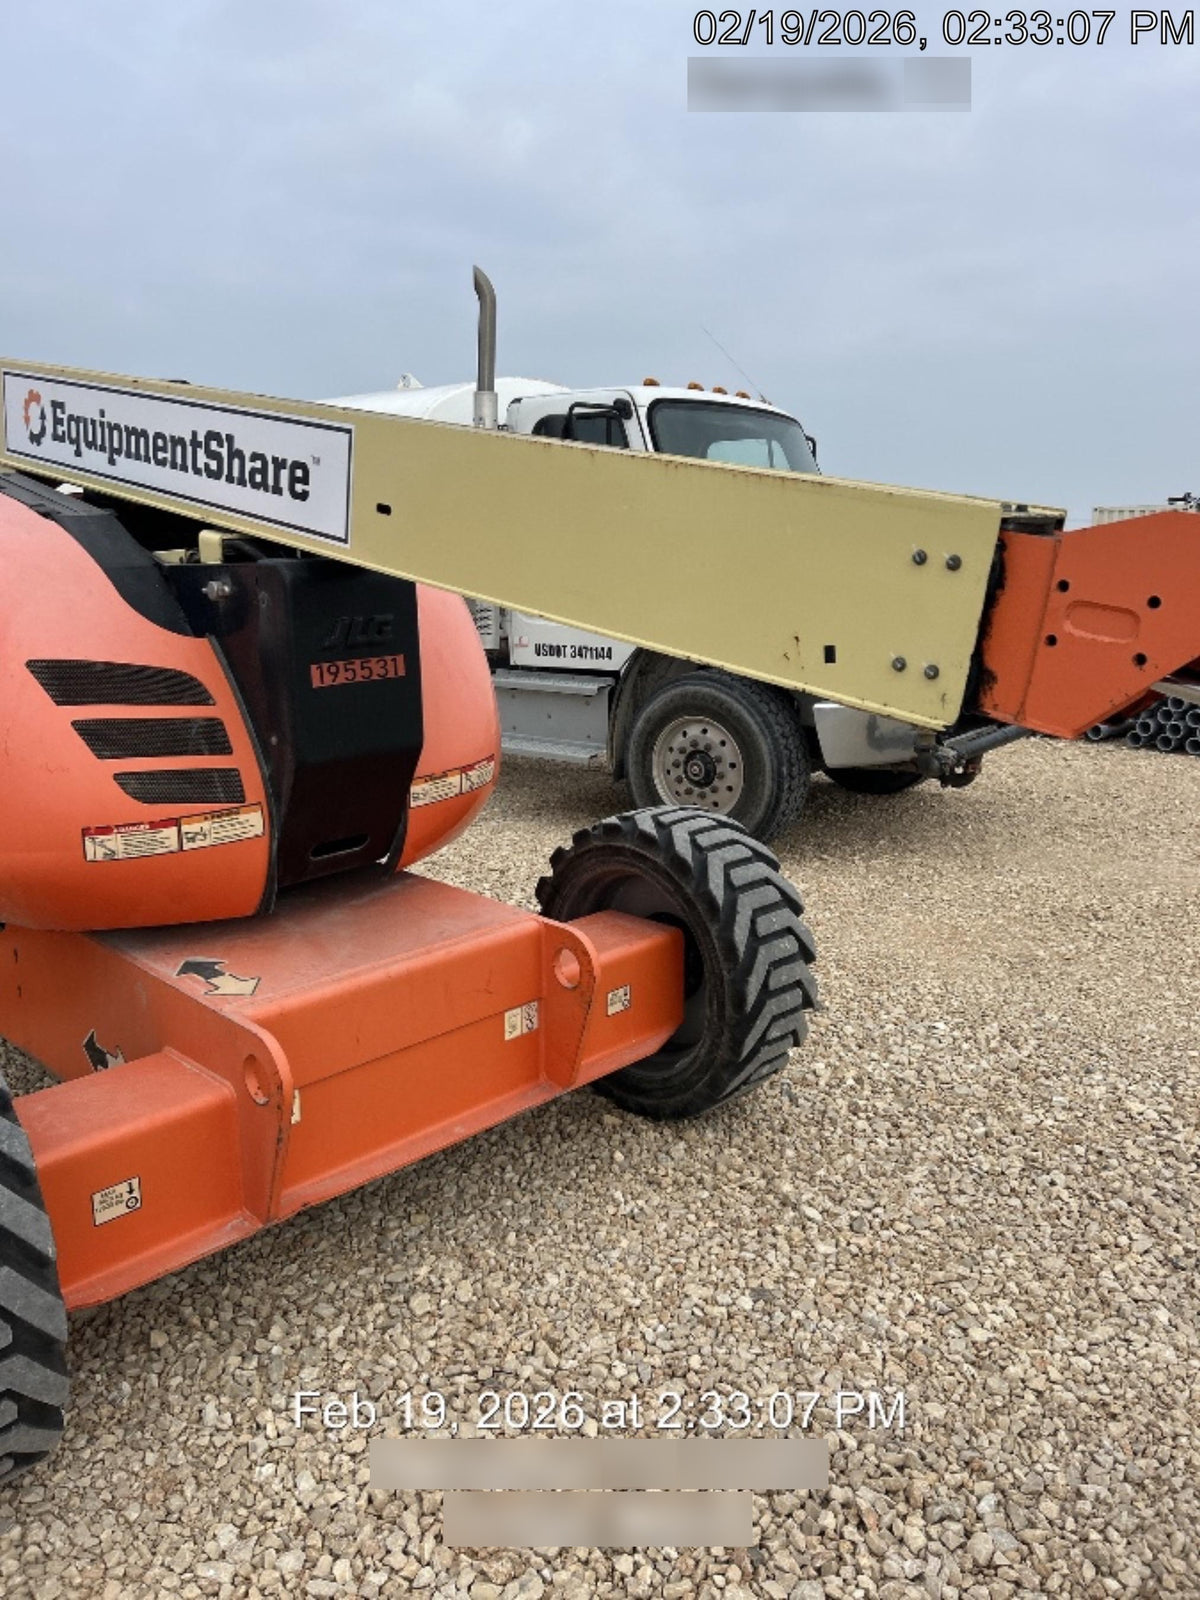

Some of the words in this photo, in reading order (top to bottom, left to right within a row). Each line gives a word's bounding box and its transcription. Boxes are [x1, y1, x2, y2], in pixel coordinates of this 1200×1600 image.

[51, 400, 311, 501] EquipmentShare
[319, 612, 393, 646] JLG
[534, 643, 568, 659] USDOT
[570, 644, 613, 661] 3471144
[315, 657, 399, 685] 195531
